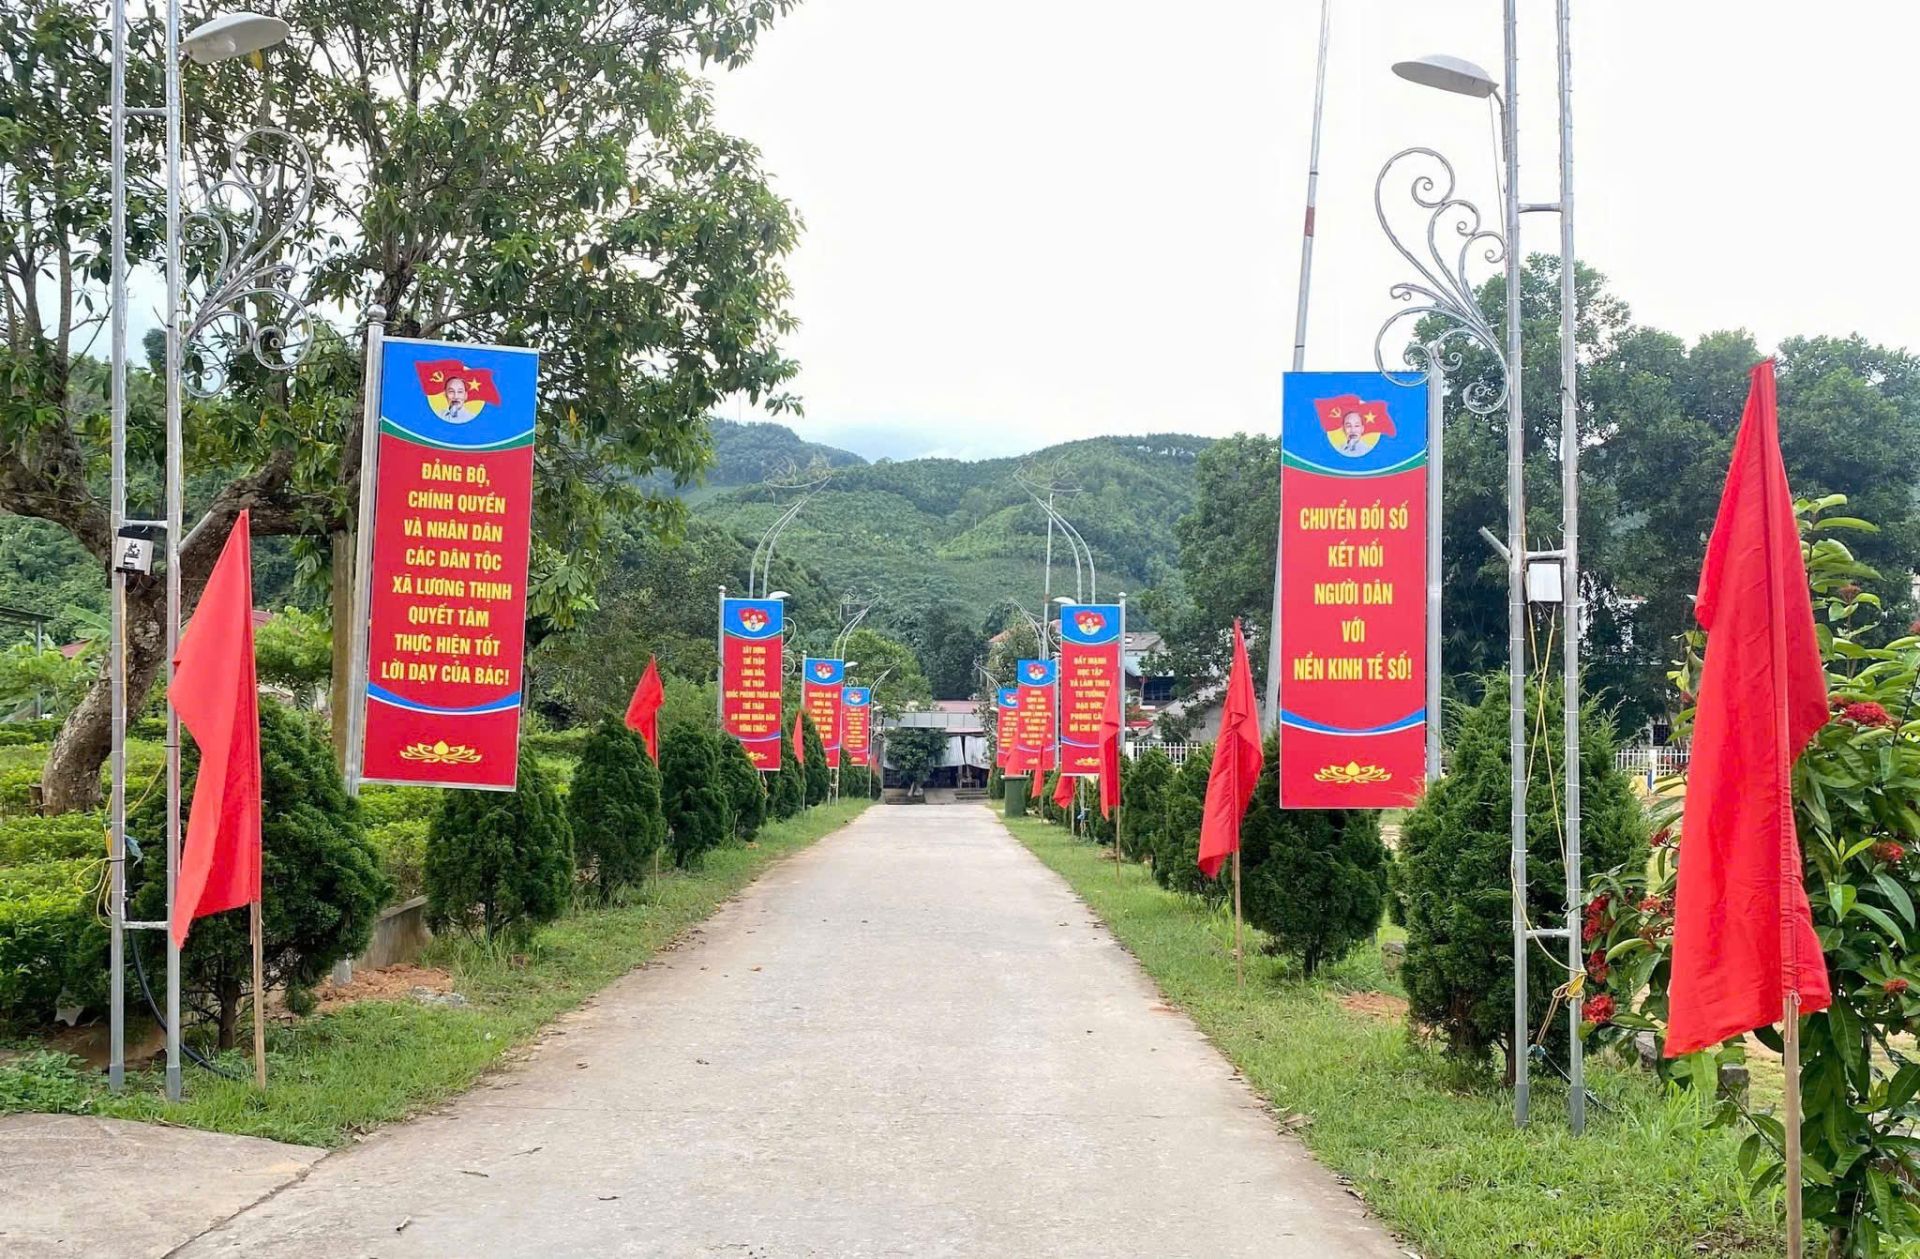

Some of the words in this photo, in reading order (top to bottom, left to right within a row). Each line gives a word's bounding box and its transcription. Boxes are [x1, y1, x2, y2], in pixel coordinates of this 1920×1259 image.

[422, 459, 461, 481] ĐẢNG
[467, 463, 490, 487] BỘ,
[408, 489, 453, 510] CHÍNH
[1300, 499, 1356, 530] CHUYỂN
[1361, 499, 1384, 530] ĐỔI
[1389, 500, 1408, 530] SỐ
[404, 518, 422, 536] VÀ
[427, 521, 468, 540] NHÂN
[472, 522, 502, 542] DÂN
[406, 546, 435, 566] CÁC
[440, 549, 470, 568] DÂN
[474, 551, 501, 574] TỘC
[1328, 539, 1355, 567] KẾT
[1359, 538, 1384, 567] NỐI
[393, 574, 412, 593] XÃ
[416, 578, 464, 596] LƯƠNG
[469, 581, 512, 602] THỊNH
[1314, 578, 1359, 605] NGƯỜI
[1363, 579, 1393, 605] DÂN
[408, 604, 454, 625] QUYẾT
[458, 608, 489, 627] TÂM
[1342, 616, 1365, 642] VỚI
[395, 634, 432, 654] THỰC
[436, 634, 471, 658] HIỆN
[475, 633, 500, 657] TỐT
[382, 660, 404, 679] LỜI
[408, 663, 437, 687] DẠY
[441, 661, 471, 684] CỦA
[475, 665, 510, 685] BÁC!
[1328, 658, 1362, 680] KINH
[1367, 652, 1384, 680] TẾ
[1388, 651, 1412, 680] SỐ!
